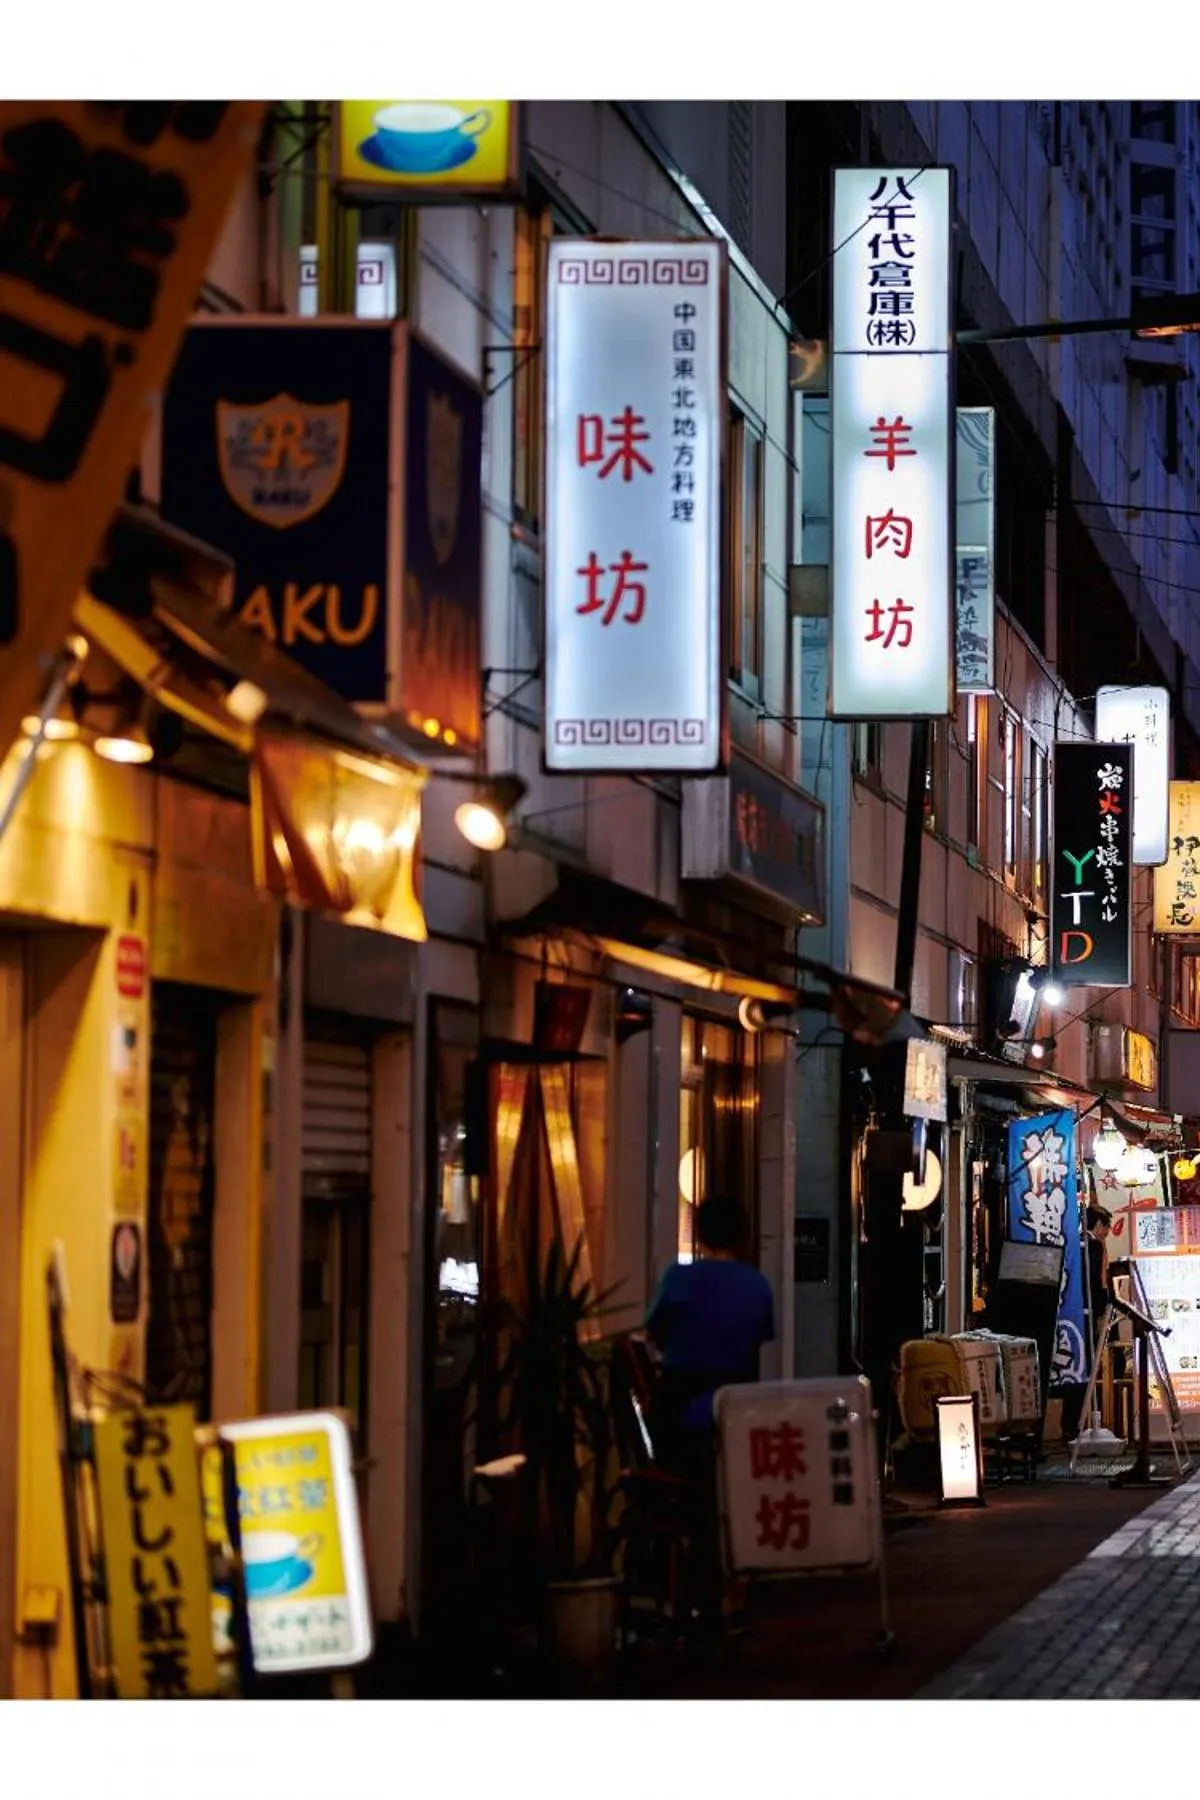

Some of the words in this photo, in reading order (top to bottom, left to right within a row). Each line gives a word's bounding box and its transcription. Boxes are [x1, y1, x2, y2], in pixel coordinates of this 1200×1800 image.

[866, 176, 916, 346] 八千代倉庫(株)
[671, 302, 698, 524] 中国東北地方料理
[576, 405, 654, 627] 味坊
[864, 415, 917, 650] 羊肉坊
[240, 582, 379, 647] AKU
[1060, 849, 1096, 964] YTD
[1096, 762, 1124, 922] 炭火串焼きバル
[122, 1414, 189, 1697] おいしい紅茶
[749, 1421, 811, 1552] 味坊
